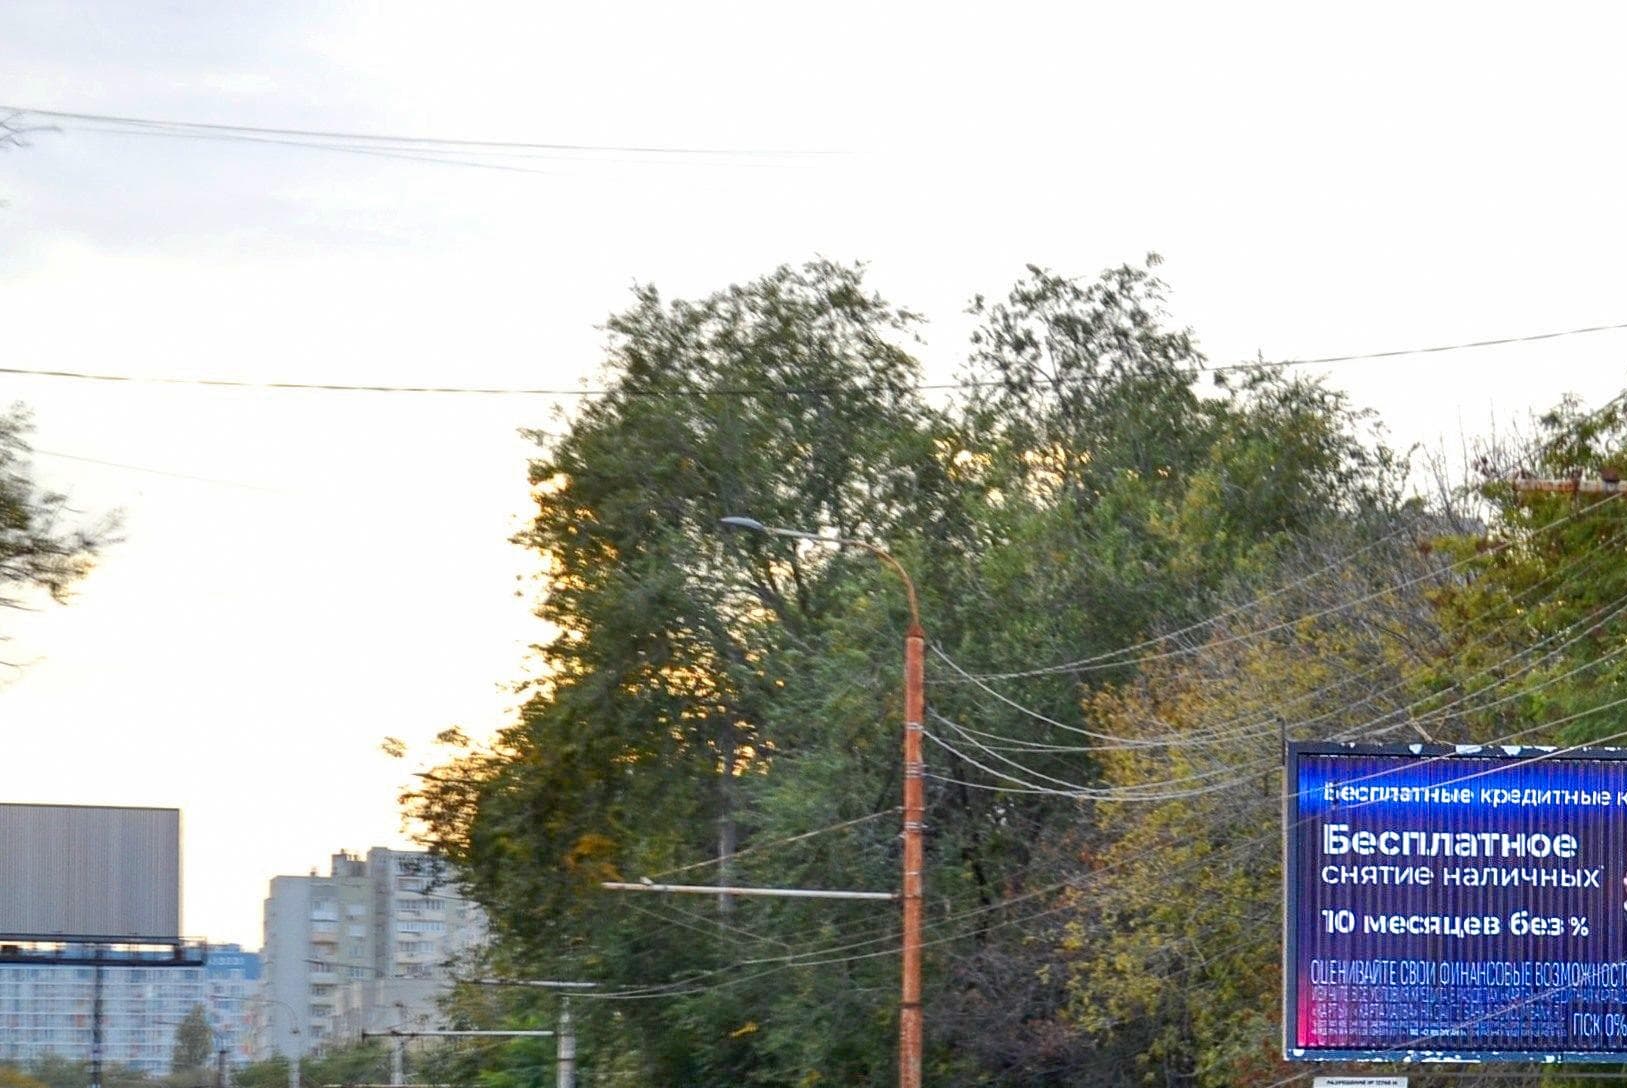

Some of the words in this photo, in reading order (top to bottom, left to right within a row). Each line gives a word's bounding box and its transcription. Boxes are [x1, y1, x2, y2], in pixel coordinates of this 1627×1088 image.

[1324, 782, 1473, 804] Бесплатные
[1480, 787, 1612, 808] кредитные
[1322, 823, 1578, 858] Бесплатное
[1321, 864, 1435, 886] снятие
[1322, 908, 1355, 935] 10
[1363, 912, 1500, 939] месяцев
[1508, 910, 1565, 936] без
[1569, 915, 1590, 937] %
[1310, 958, 1398, 986] ОЦЕНИВАЙТЕ
[1400, 960, 1436, 986] СВОИ
[1439, 959, 1532, 987] ФИНАНСОВЫЕ
[1573, 1012, 1600, 1038] ПСК
